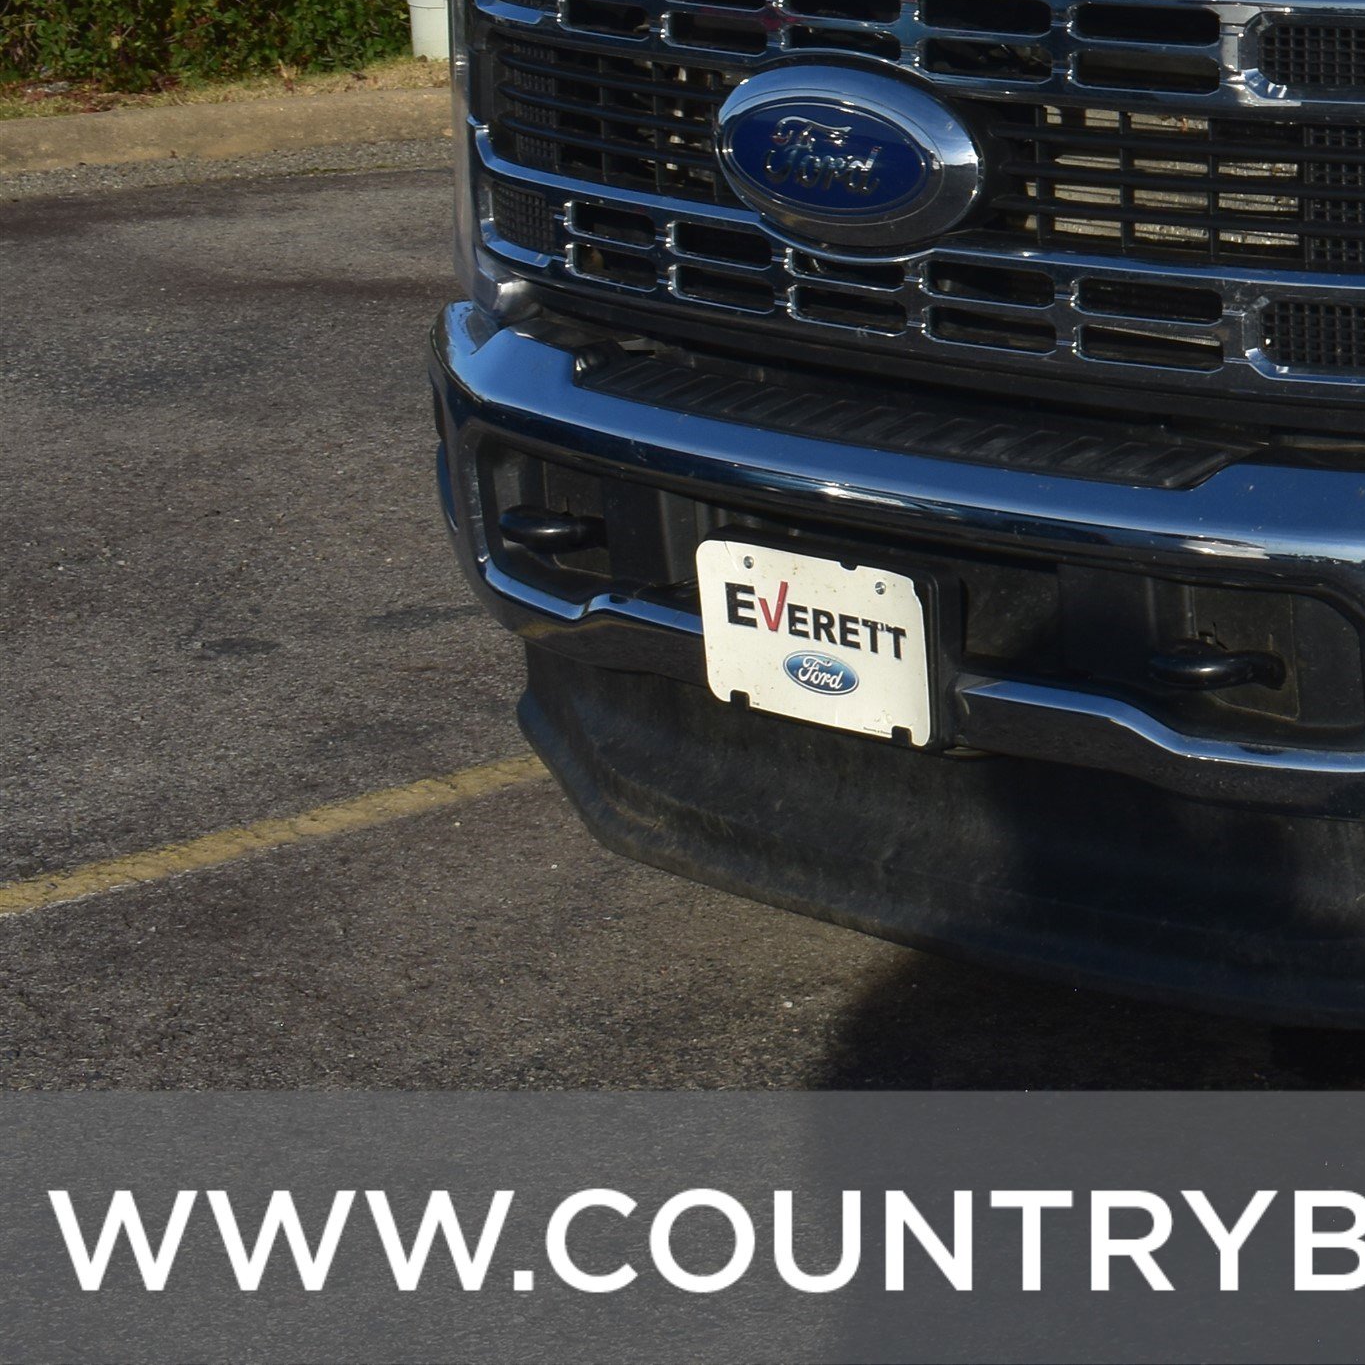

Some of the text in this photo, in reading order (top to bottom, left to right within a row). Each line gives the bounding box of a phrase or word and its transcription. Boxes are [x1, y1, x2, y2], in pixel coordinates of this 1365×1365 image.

[763, 115, 882, 196] Ford
[724, 581, 907, 661] EVERETT
[798, 656, 844, 690] Ford
